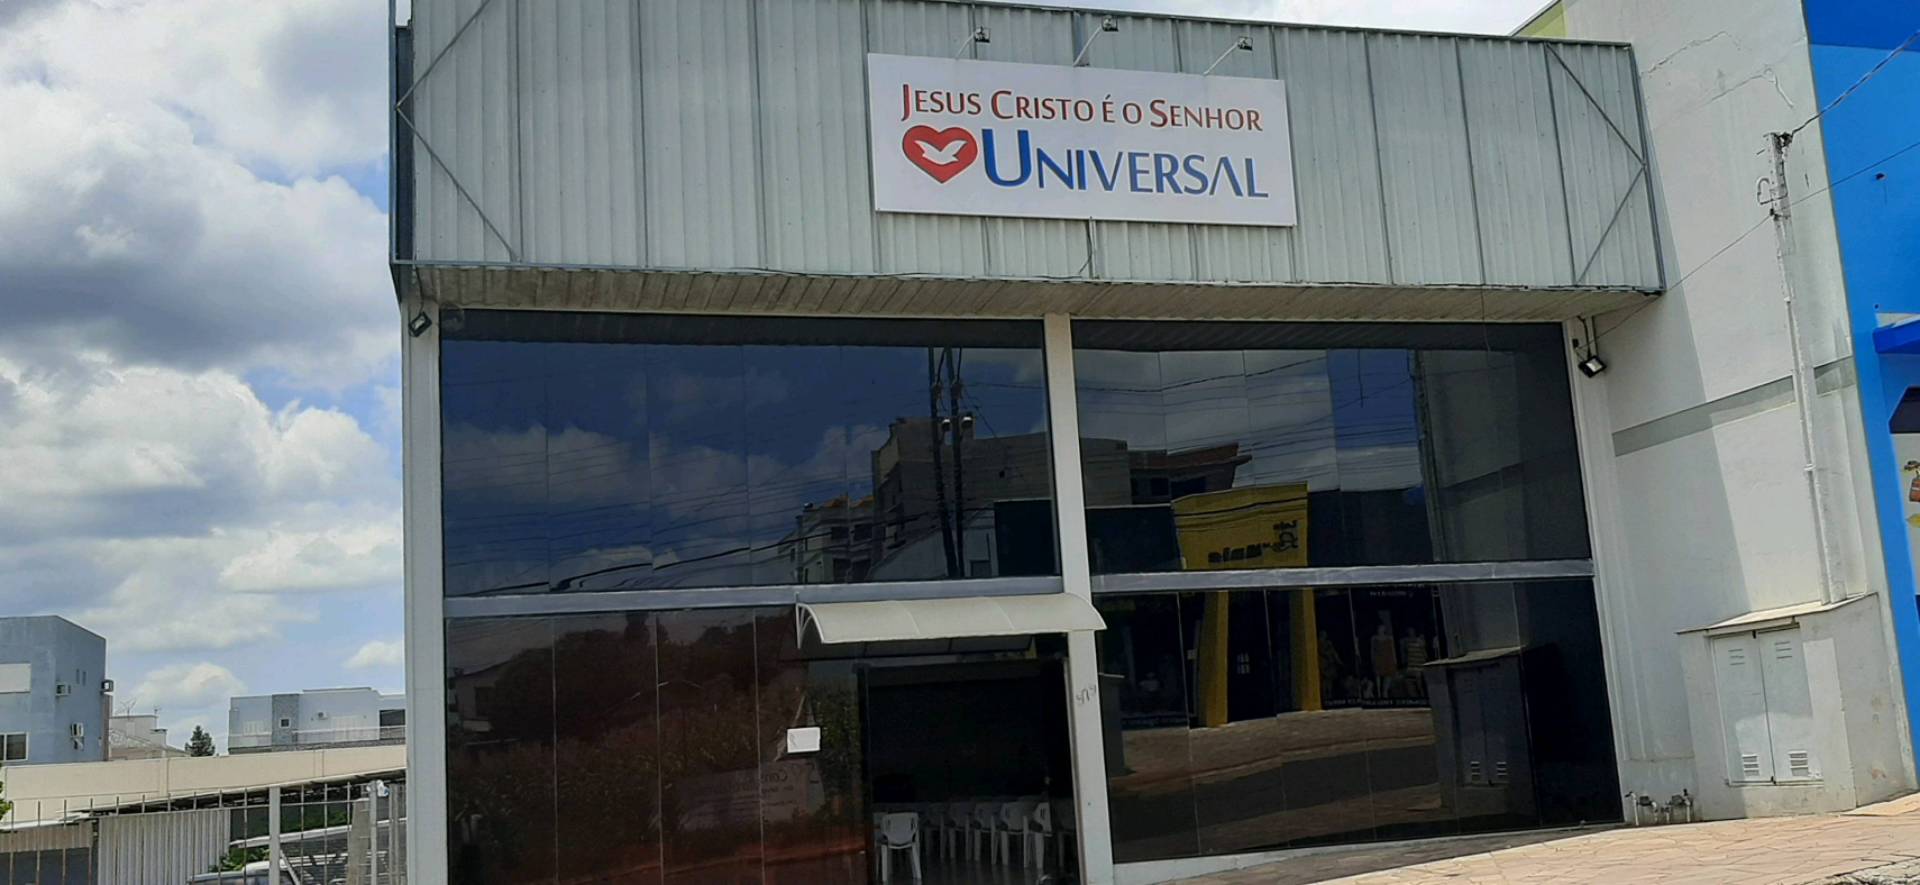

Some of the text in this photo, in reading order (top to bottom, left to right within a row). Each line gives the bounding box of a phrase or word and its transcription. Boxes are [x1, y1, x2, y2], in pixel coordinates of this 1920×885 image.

[901, 84, 1263, 131] JESUS CRISTO É O SENHOR
[981, 128, 1269, 198] UNIVERSAL
